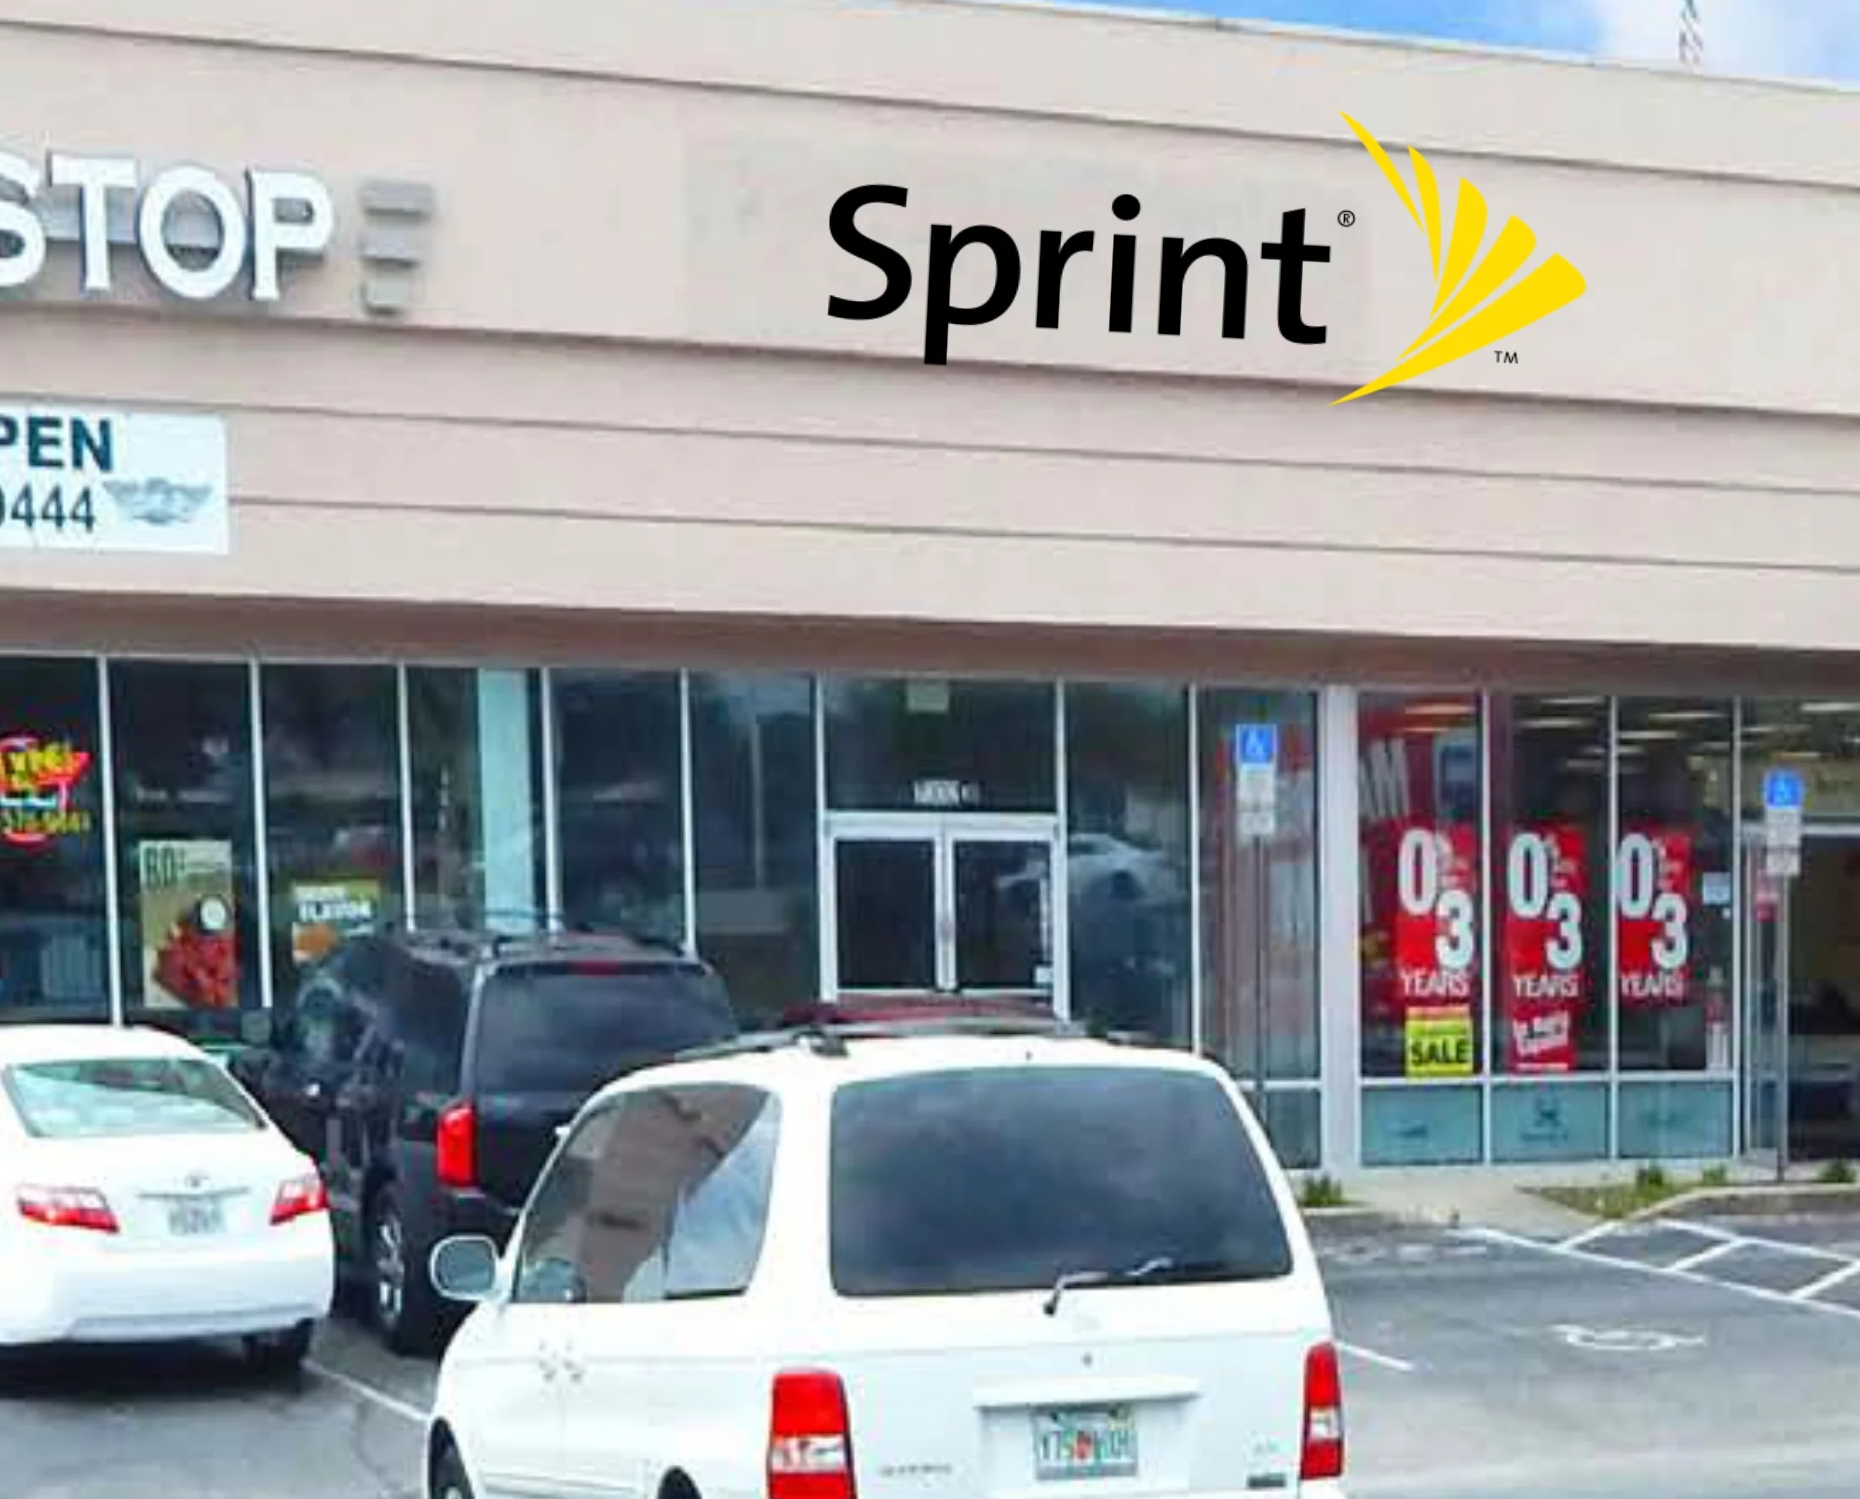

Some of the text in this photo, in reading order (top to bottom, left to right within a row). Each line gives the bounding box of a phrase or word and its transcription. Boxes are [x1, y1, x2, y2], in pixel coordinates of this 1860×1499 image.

[1399, 969, 1471, 998] YEARS
[1512, 973, 1580, 999] YEARS
[1620, 973, 1686, 999] YEARS
[1410, 1038, 1469, 1068] SALE
